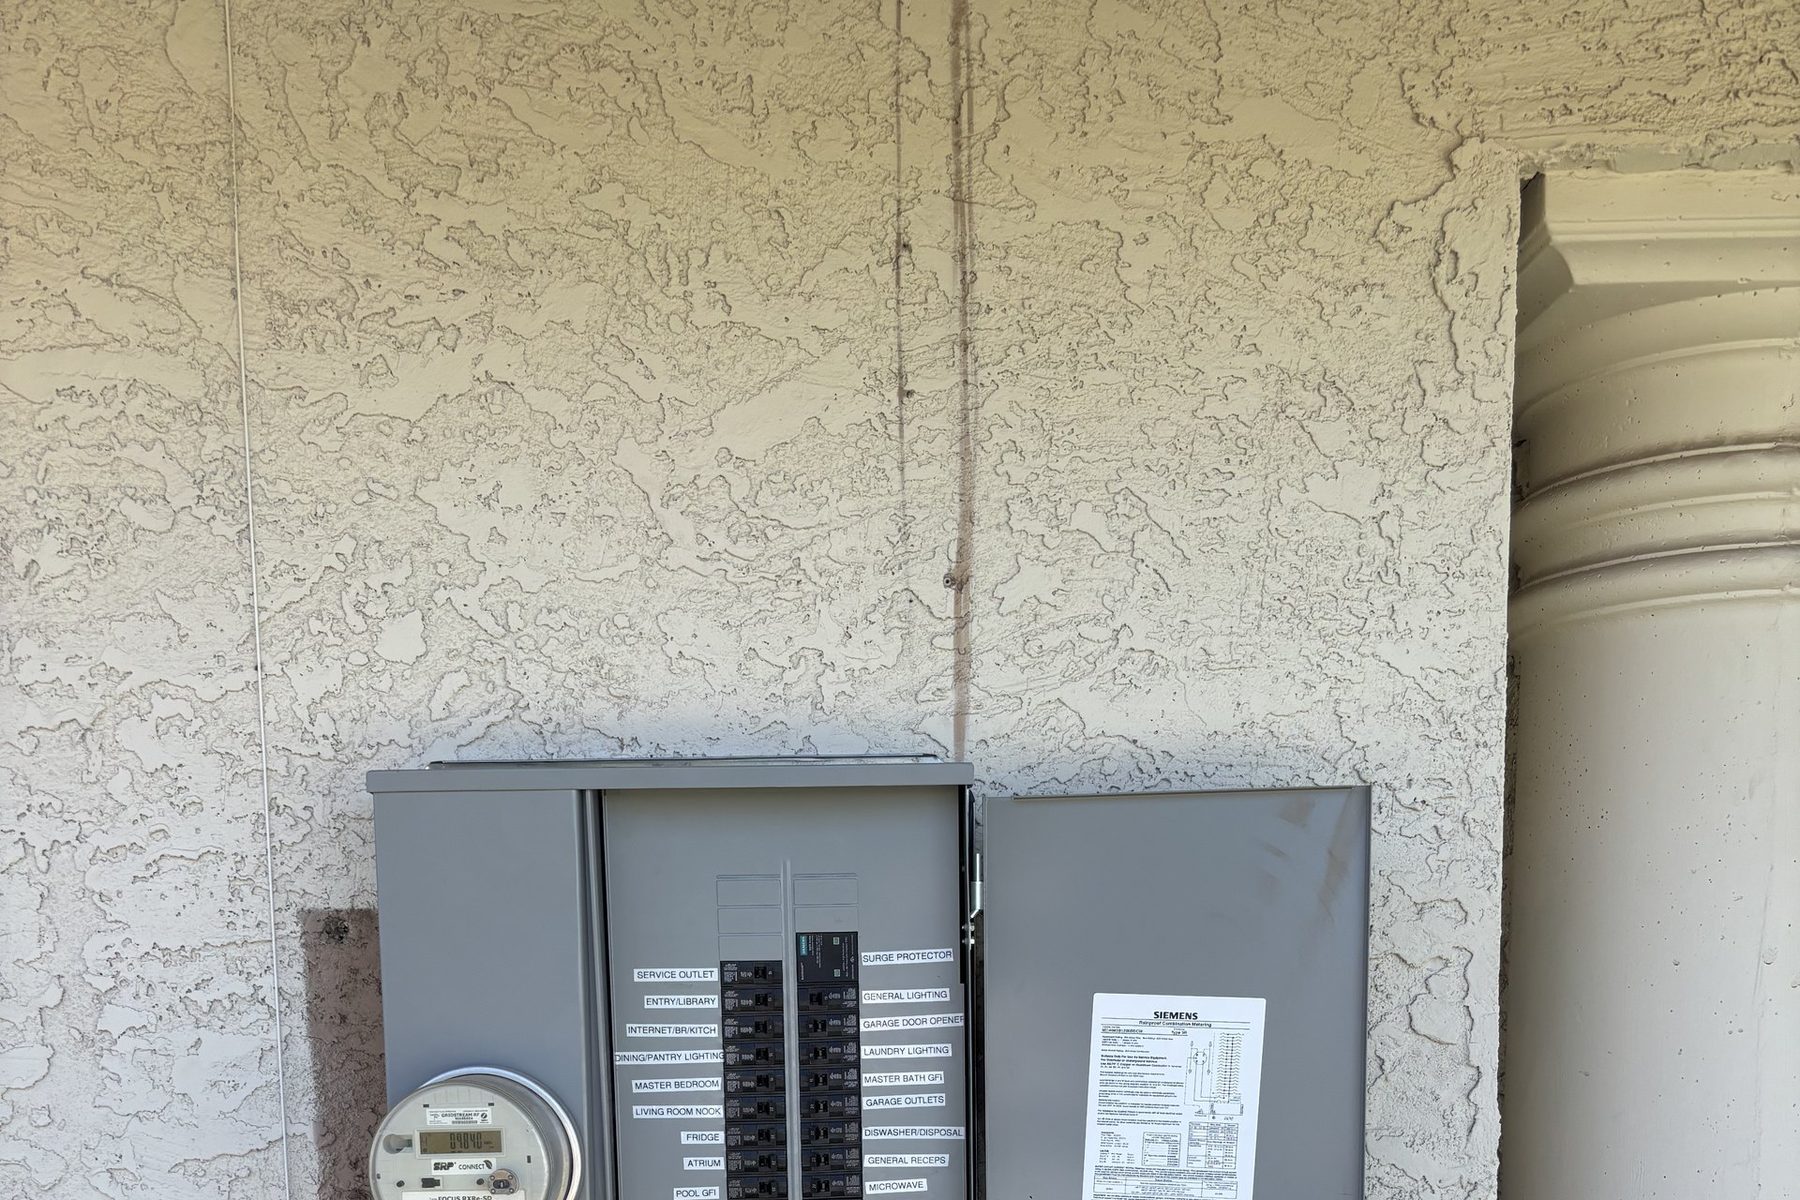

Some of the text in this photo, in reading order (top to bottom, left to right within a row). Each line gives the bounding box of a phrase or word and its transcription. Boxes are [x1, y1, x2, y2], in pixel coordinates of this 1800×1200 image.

[862, 951, 952, 963] SURGE PROTECTOR
[637, 970, 677, 979] SERVICE
[678, 970, 715, 979] OUTLET
[863, 991, 905, 1001] GENERAL
[906, 990, 948, 1000] LIGHTING
[646, 997, 717, 1006] ENTRY/LIBRARY
[1153, 1011, 1198, 1020] SIEMENS
[863, 1019, 900, 1029] GARAGE
[902, 1018, 928, 1027] DOOR
[628, 1026, 717, 1035] INTERNET/BR/KITCH
[864, 1046, 949, 1056] LAUNDRY LIGHTING
[684, 1052, 724, 1061] LIGHTING
[864, 1073, 943, 1084] MASTER BATH GFI
[634, 1080, 720, 1090] MASTER BEDROOM
[865, 1095, 945, 1106] GARAGE OUTLETS
[635, 1106, 722, 1116] LIVING ROOM NOOK
[686, 1133, 720, 1142] FRIDGE
[864, 1128, 963, 1138] DISWASHER/DISPOSAL
[687, 1159, 721, 1168] ATRIUM
[868, 1156, 946, 1165] GENERAL RECEPS
[869, 1181, 924, 1191] MICROWAVE
[676, 1189, 717, 1198] POOL GFI
